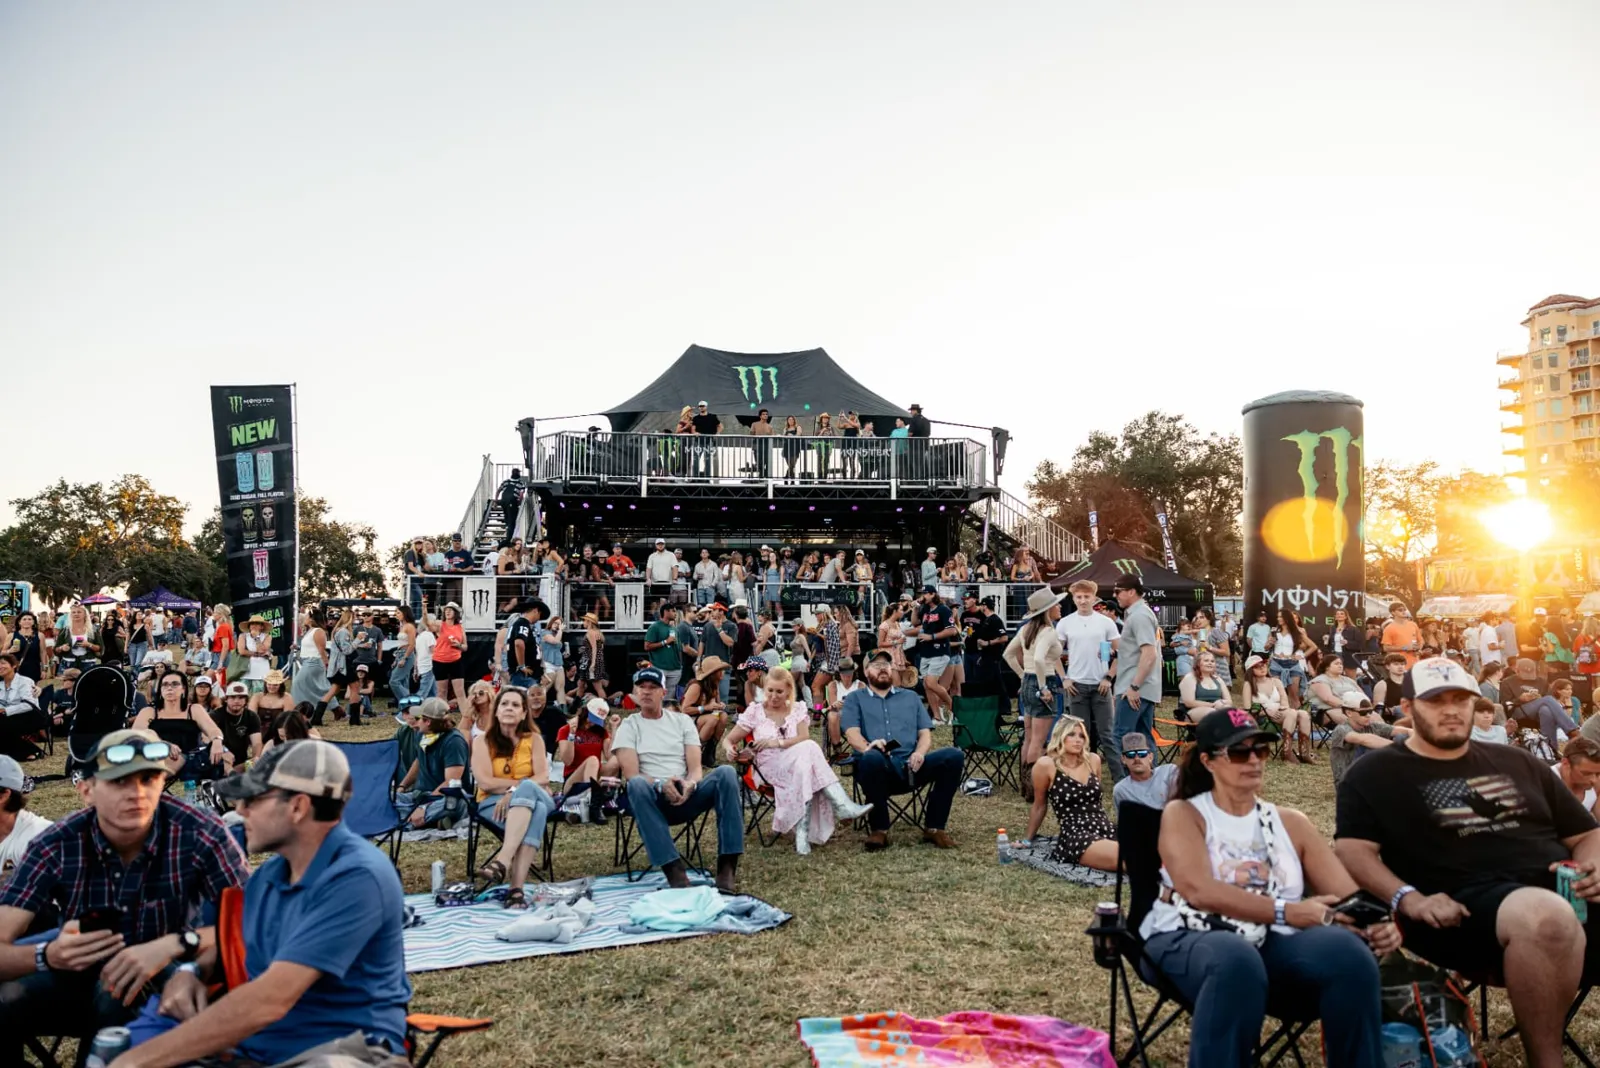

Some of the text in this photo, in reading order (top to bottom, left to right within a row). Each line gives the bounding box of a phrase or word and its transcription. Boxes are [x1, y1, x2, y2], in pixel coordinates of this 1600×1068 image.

[231, 419, 275, 446] NEW
[1261, 584, 1367, 611] MONST
[519, 625, 529, 637] 12
